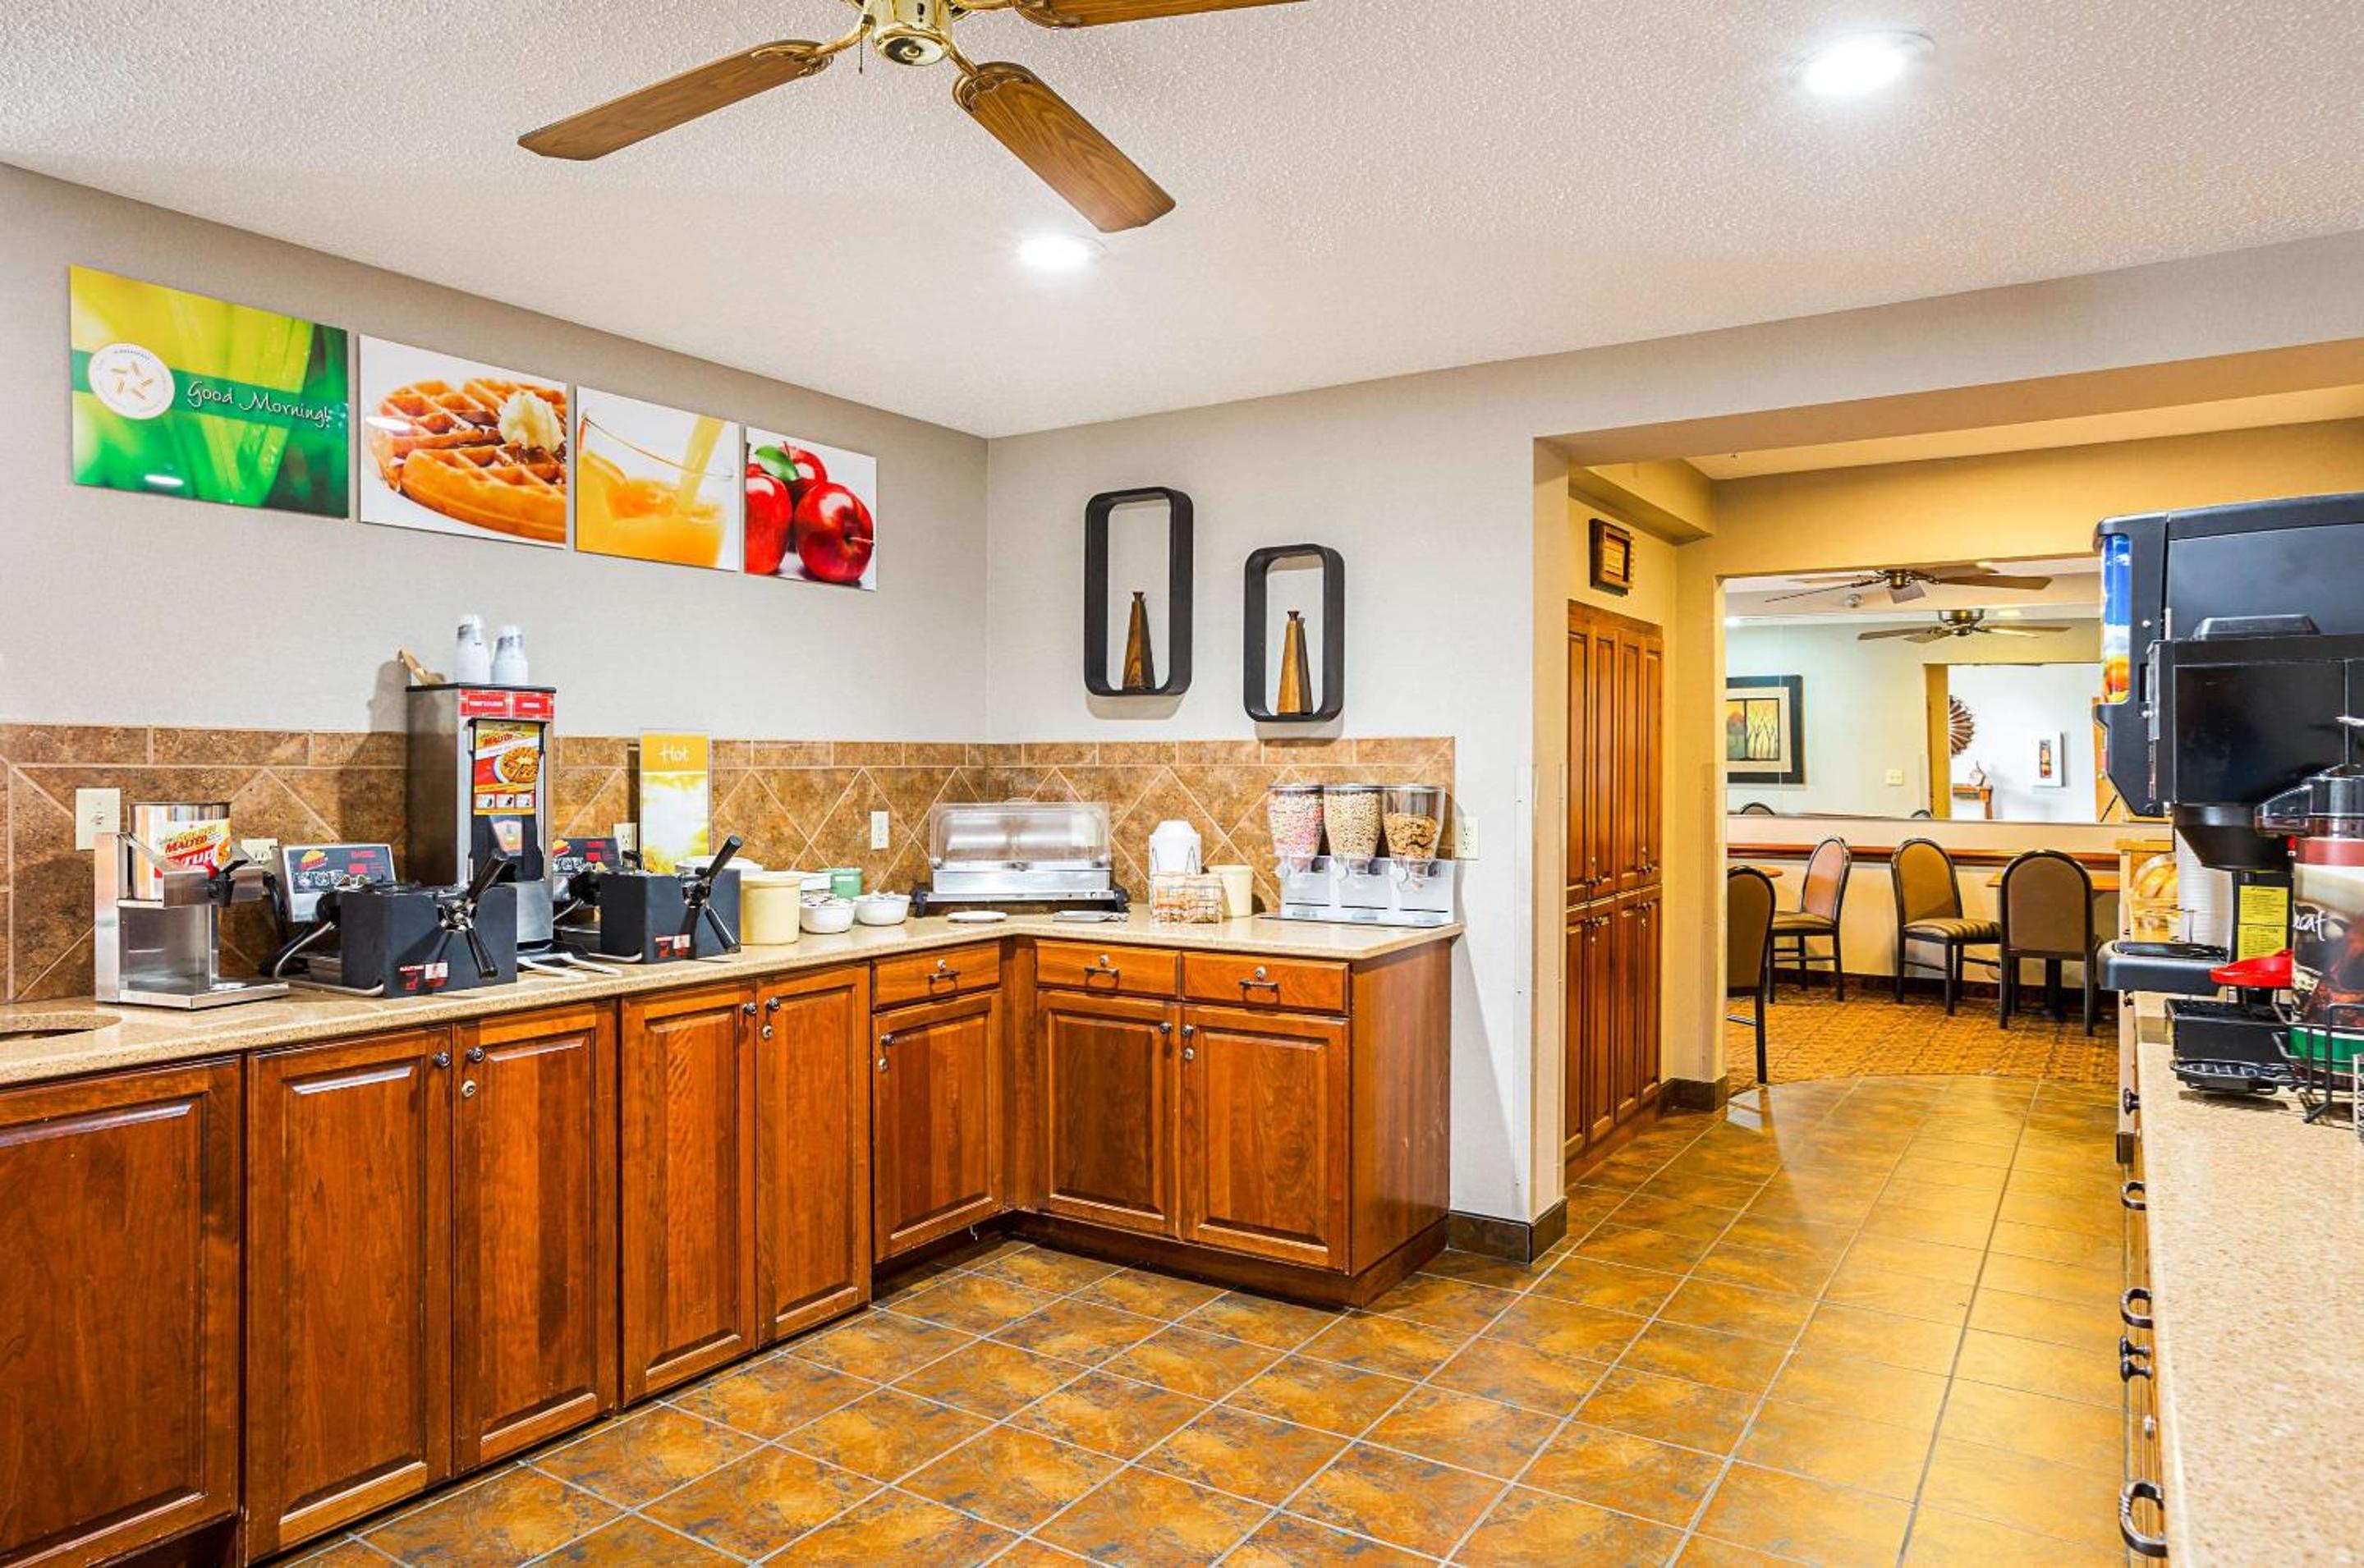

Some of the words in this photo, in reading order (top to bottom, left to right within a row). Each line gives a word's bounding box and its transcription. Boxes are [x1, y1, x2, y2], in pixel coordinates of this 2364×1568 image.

[187, 380, 233, 407] Good
[239, 392, 330, 428] Morning!
[658, 744, 690, 763] Hot
[166, 835, 208, 853] MALTED
